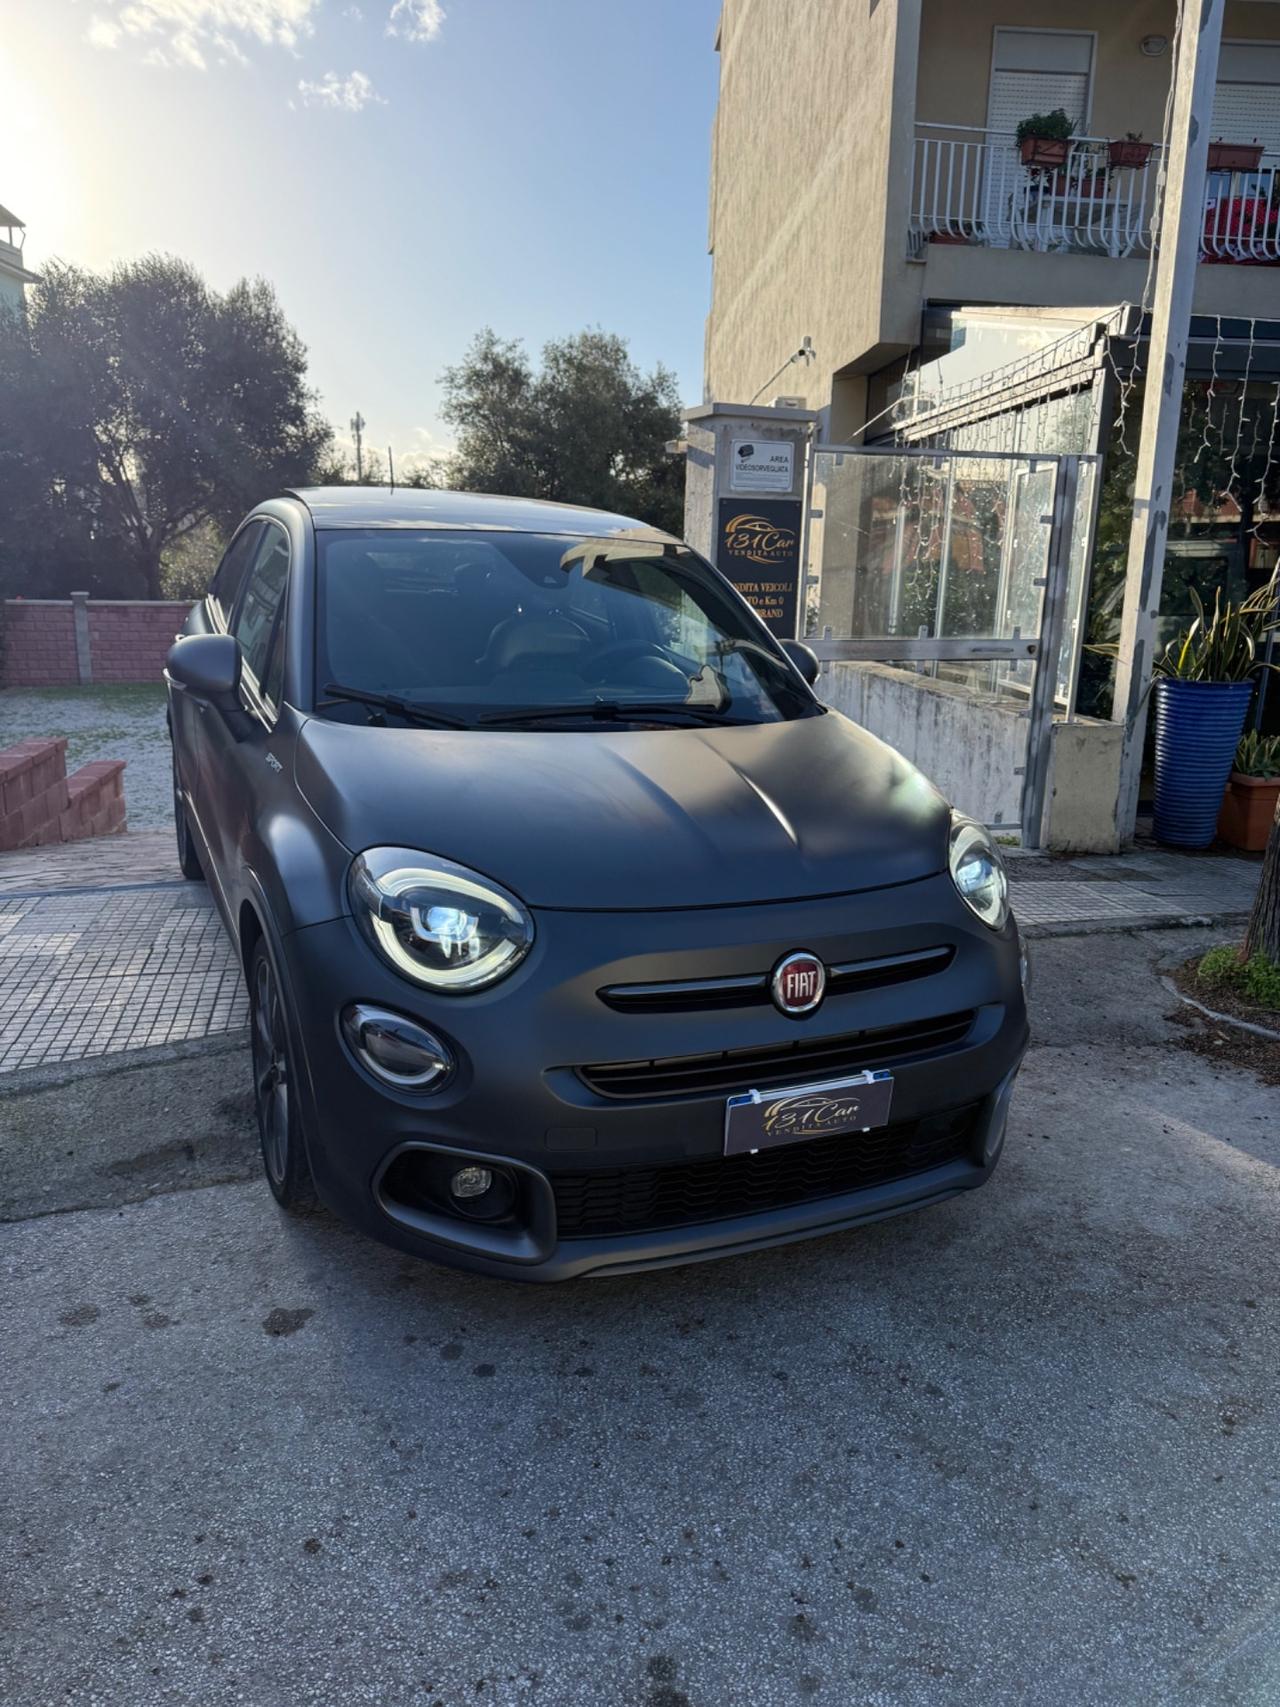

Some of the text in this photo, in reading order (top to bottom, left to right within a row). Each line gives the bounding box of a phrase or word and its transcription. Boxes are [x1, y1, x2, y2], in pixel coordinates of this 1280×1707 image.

[770, 456, 788, 464] AREA
[728, 549, 794, 557] VENDITA AUTO
[787, 971, 816, 999] FIAT
